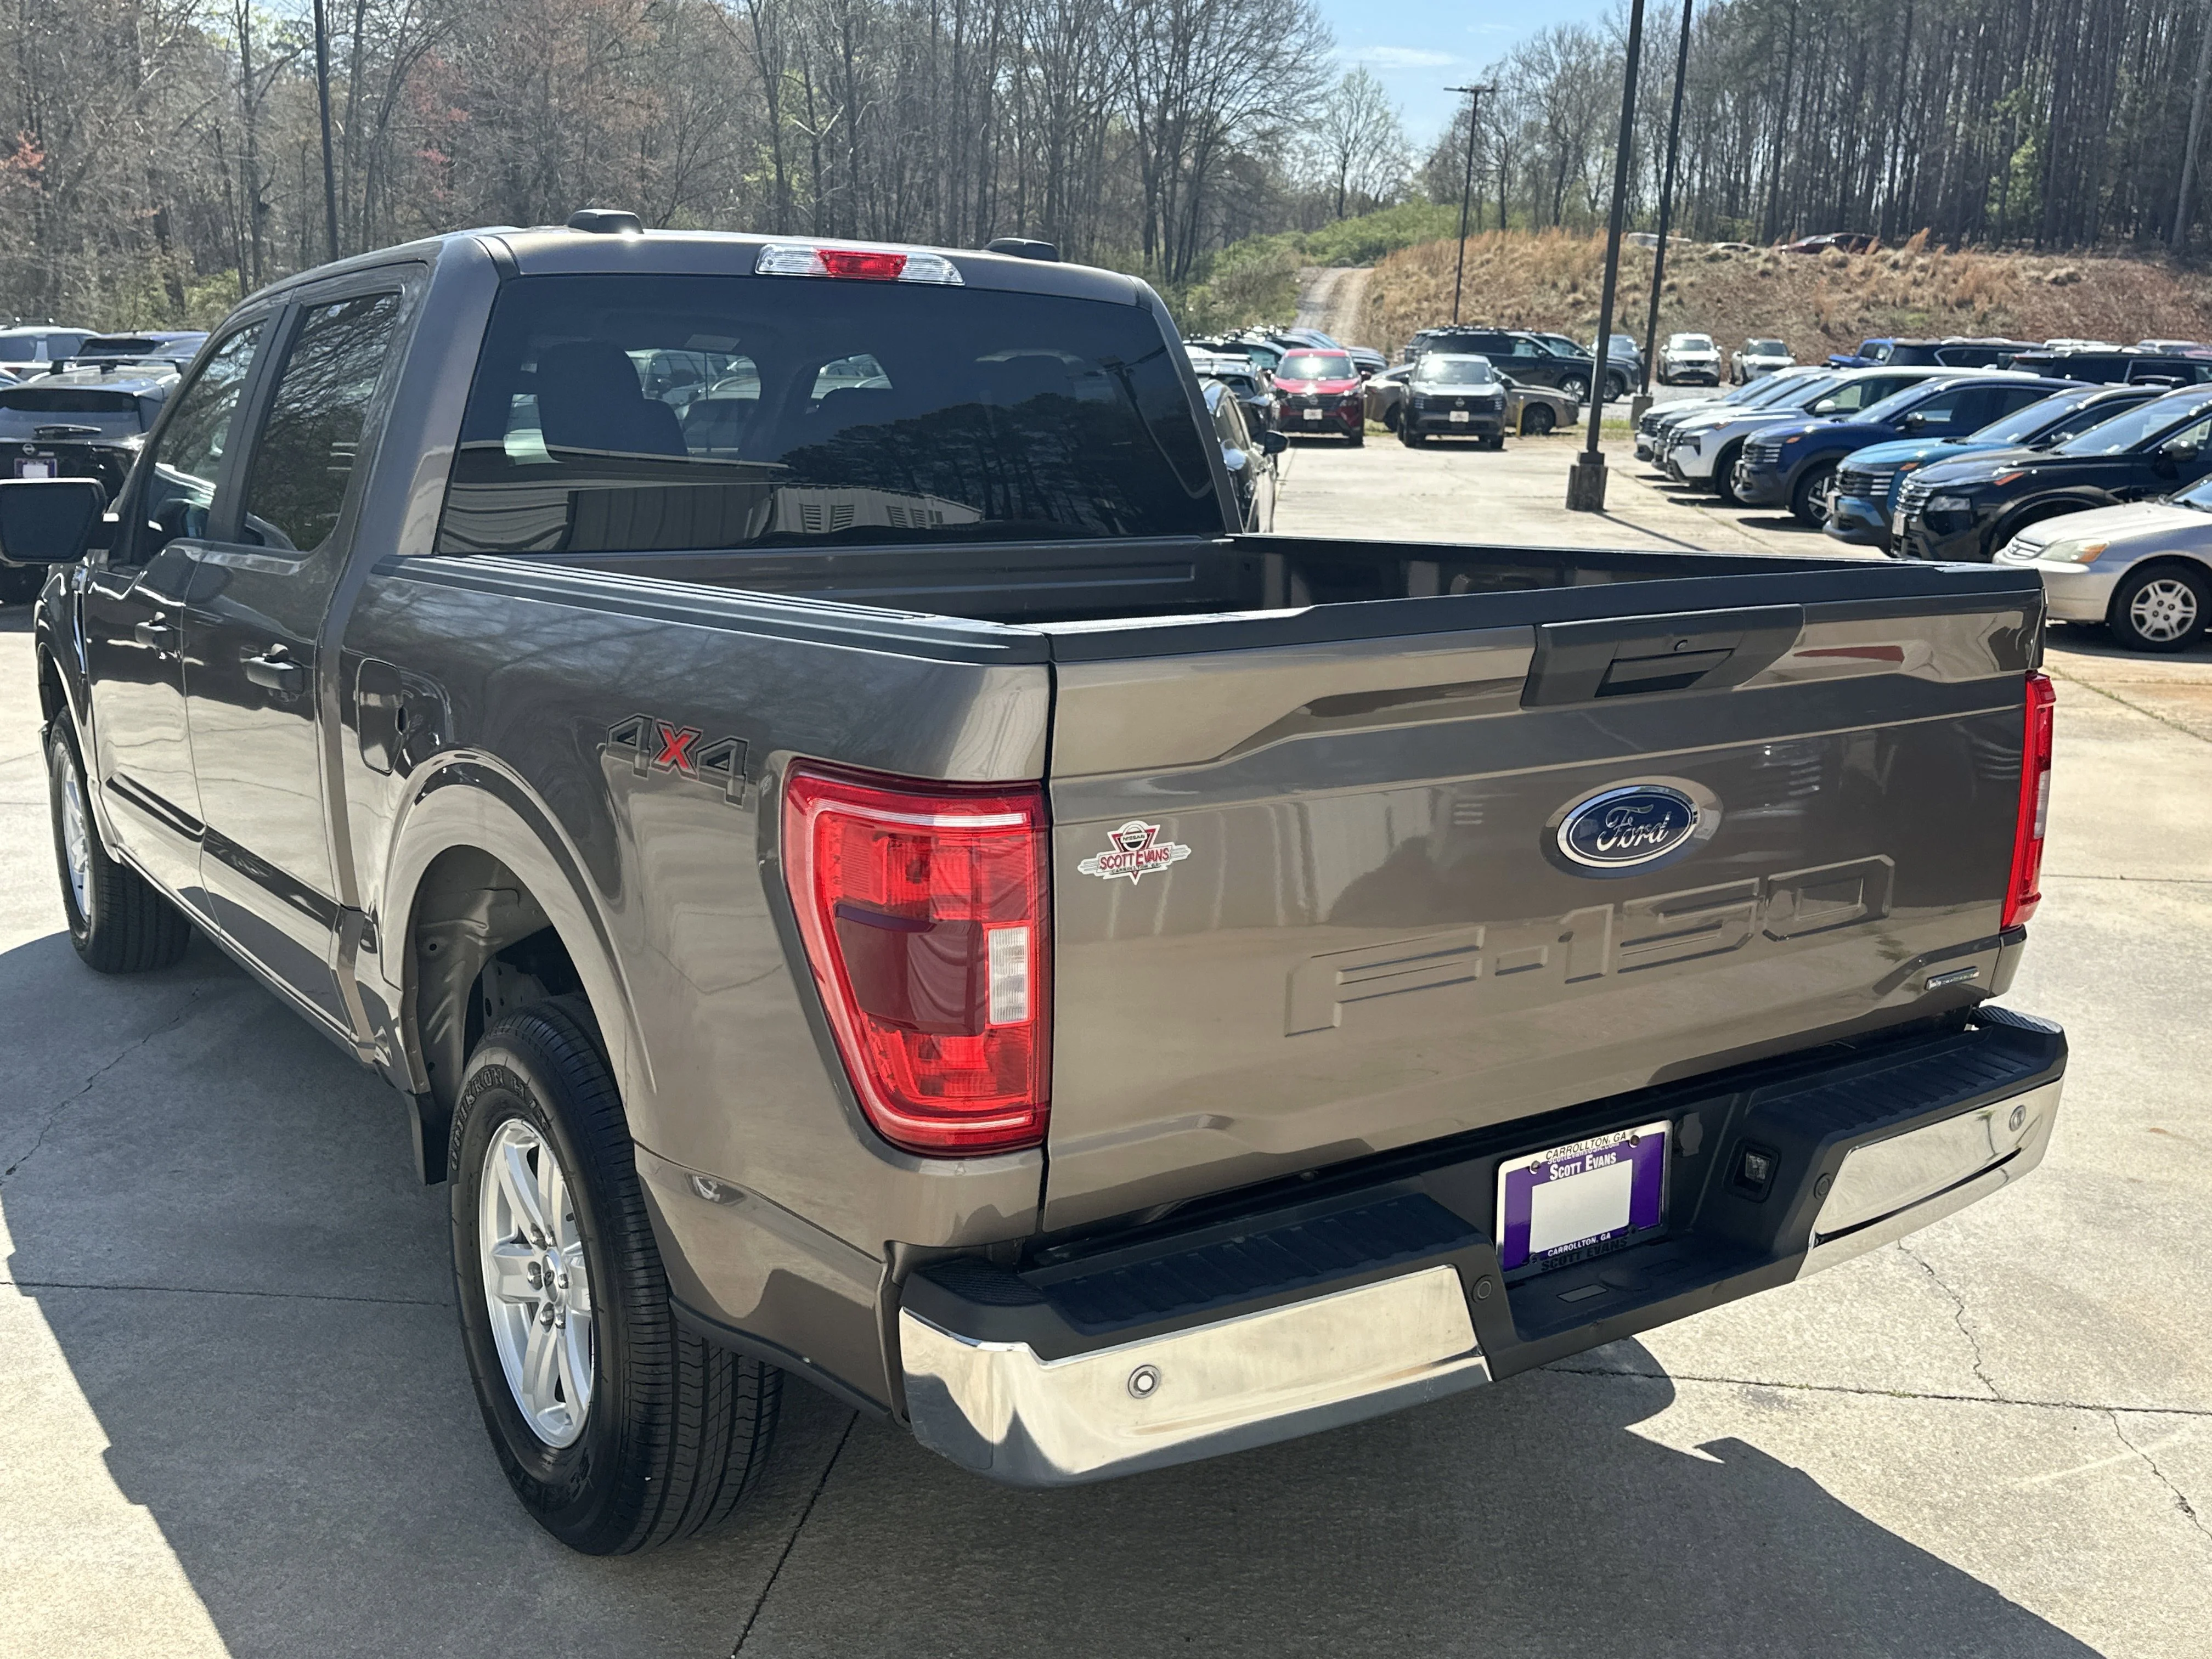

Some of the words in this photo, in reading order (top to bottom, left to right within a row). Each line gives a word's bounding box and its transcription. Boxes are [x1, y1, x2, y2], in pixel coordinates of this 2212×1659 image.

[1596, 803, 1672, 851] Ford
[1099, 853, 1135, 870] SCOTT
[1136, 848, 1170, 865] EVANS
[1284, 855, 1895, 1038] F-150
[1546, 1135, 1611, 1160] CARROLLTON,
[1613, 1131, 1626, 1142] GA
[1549, 1161, 1582, 1181] SCOTT
[1585, 1152, 1617, 1171] EVANS
[1600, 1232, 1611, 1242] GA
[1541, 1250, 1582, 1272] SCOTT
[1586, 1237, 1628, 1257] EVANS
